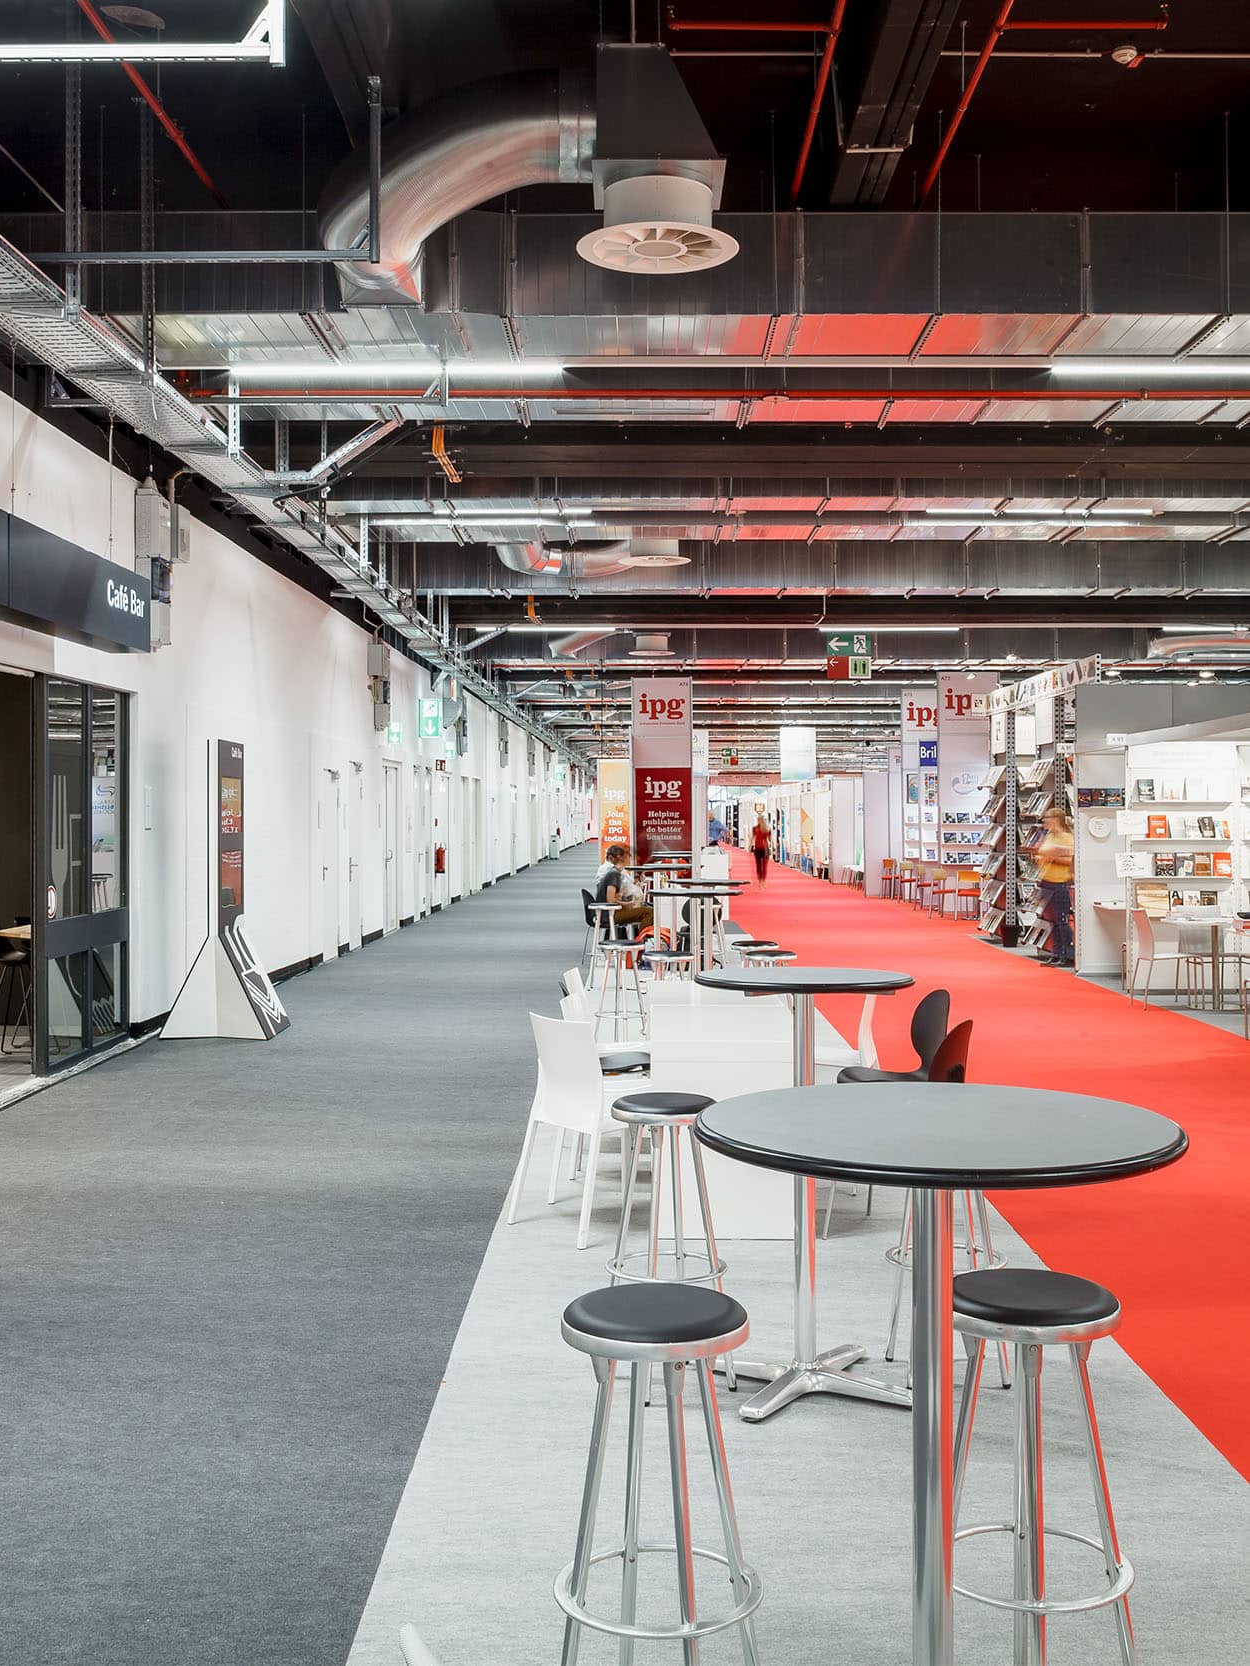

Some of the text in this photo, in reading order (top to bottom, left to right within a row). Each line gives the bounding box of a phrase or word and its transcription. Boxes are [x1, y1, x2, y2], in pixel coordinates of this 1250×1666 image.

[107, 579, 145, 618] Café Bar
[639, 693, 686, 720] ipg
[945, 687, 972, 716] ip
[644, 776, 683, 799] ipg
[642, 818, 686, 827] publishers
[647, 810, 680, 819] Helping
[608, 826, 623, 834] IPG
[604, 834, 628, 843] today
